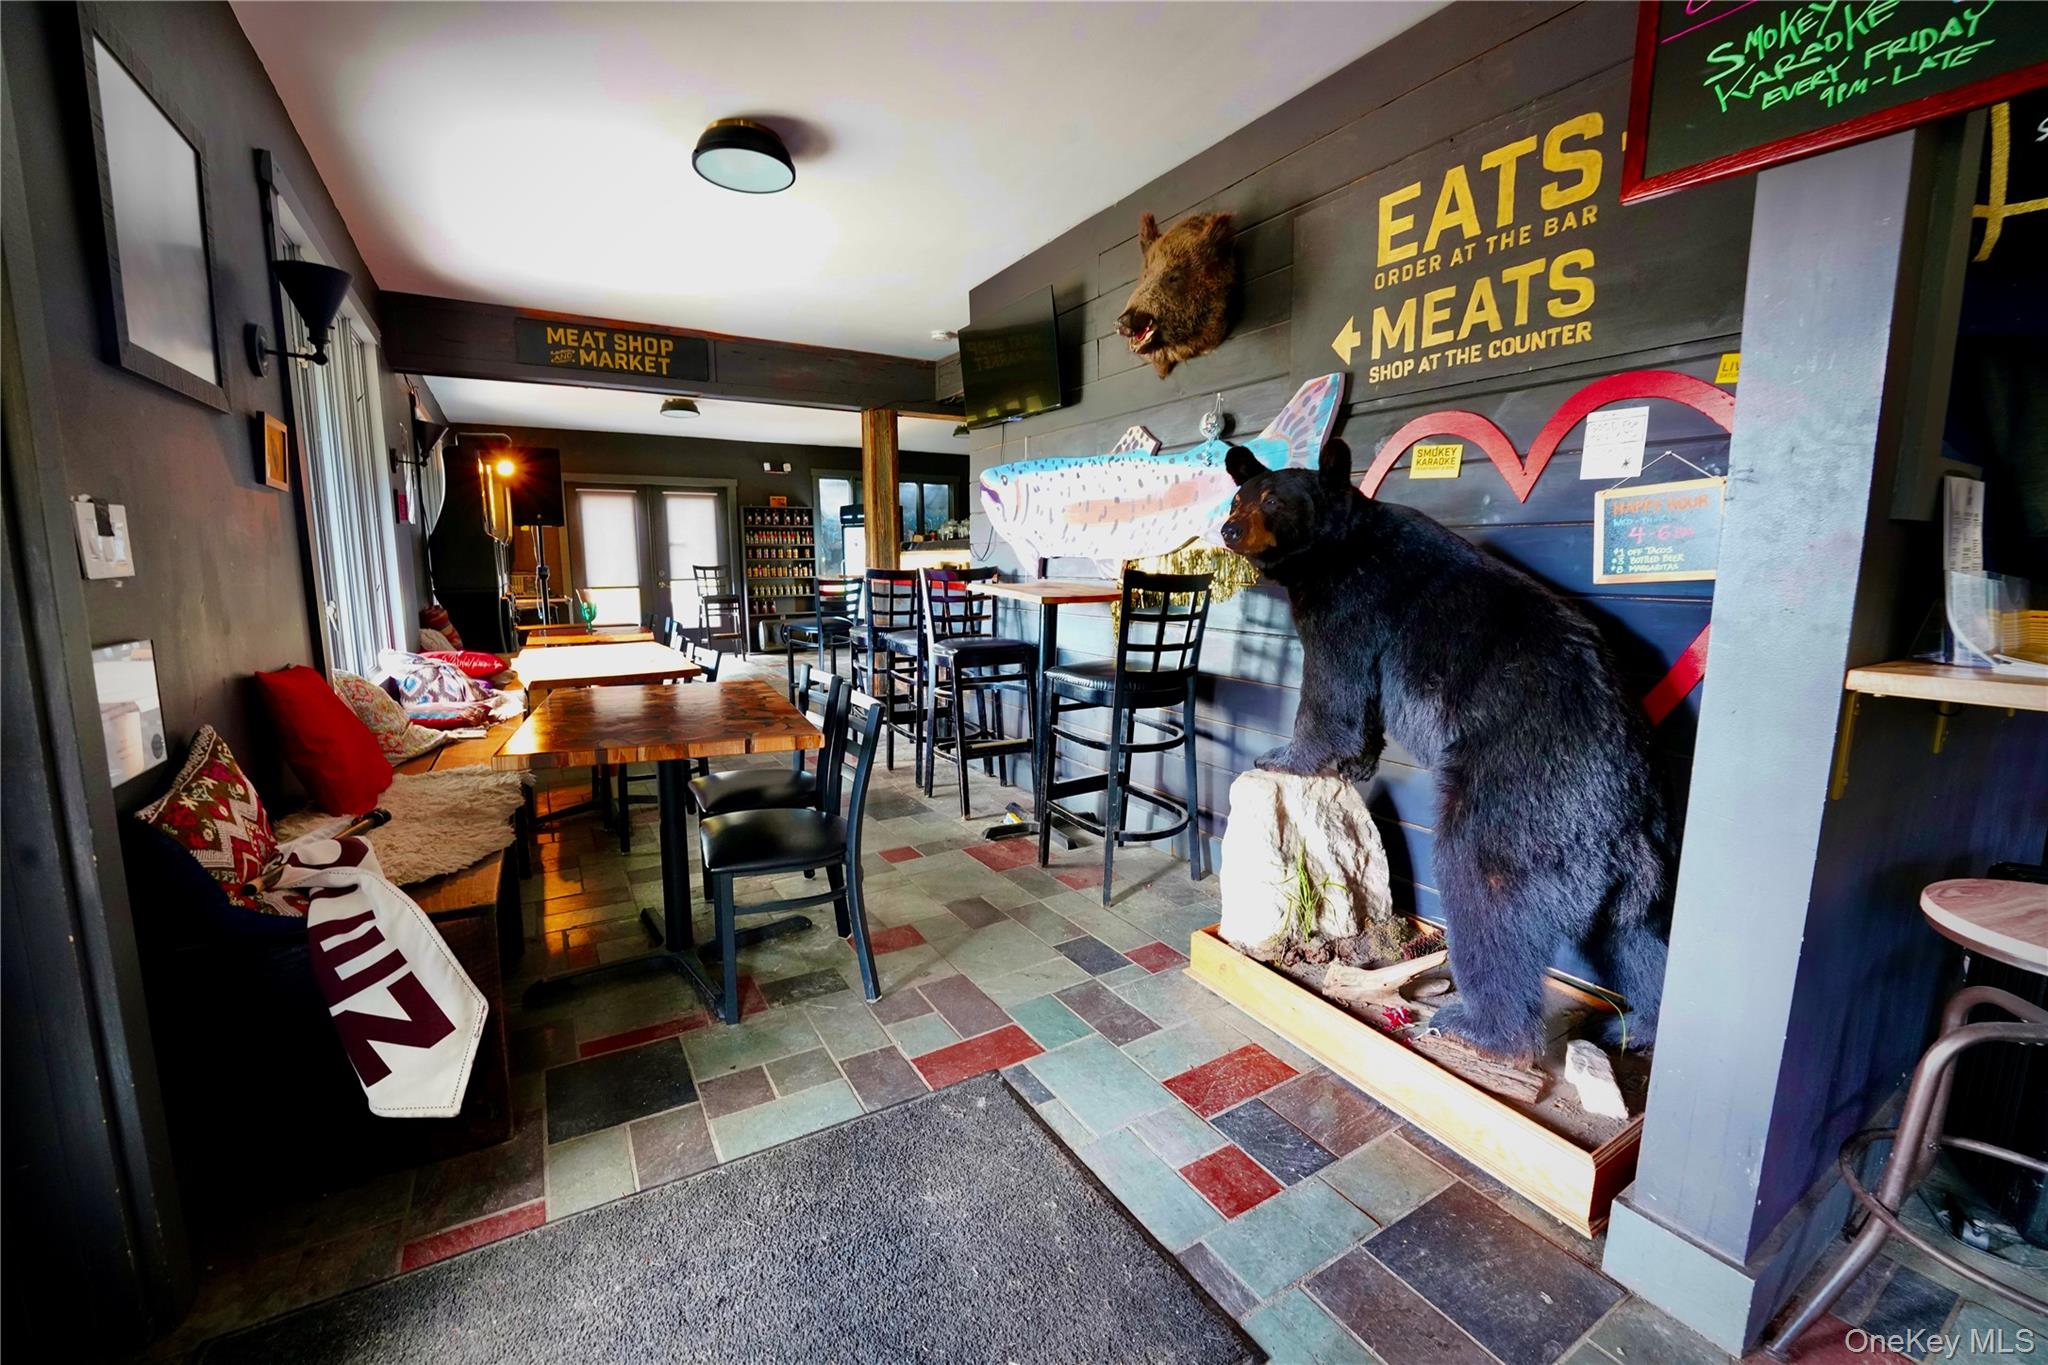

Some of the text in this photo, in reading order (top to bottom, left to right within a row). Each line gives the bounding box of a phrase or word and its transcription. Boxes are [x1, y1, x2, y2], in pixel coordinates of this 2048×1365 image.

[1703, 0, 1839, 87] SMOKEY
[1762, 1, 1995, 110] EVERY FRIDAY
[1376, 111, 1605, 267] EATS
[1374, 204, 1599, 291] ORDER AT THE BAR
[1371, 248, 1596, 361] MEATS
[546, 327, 674, 356] MEAT SHOP
[579, 349, 671, 375] MARKET
[1368, 321, 1593, 384] SHOP AT THE COUNTER
[1416, 457, 1456, 466] KARAOKE
[1417, 447, 1458, 458] SMOKEY
[1612, 498, 1664, 516] HAPPY
[1627, 548, 1643, 556] OFF
[1645, 546, 1673, 554] TACOS
